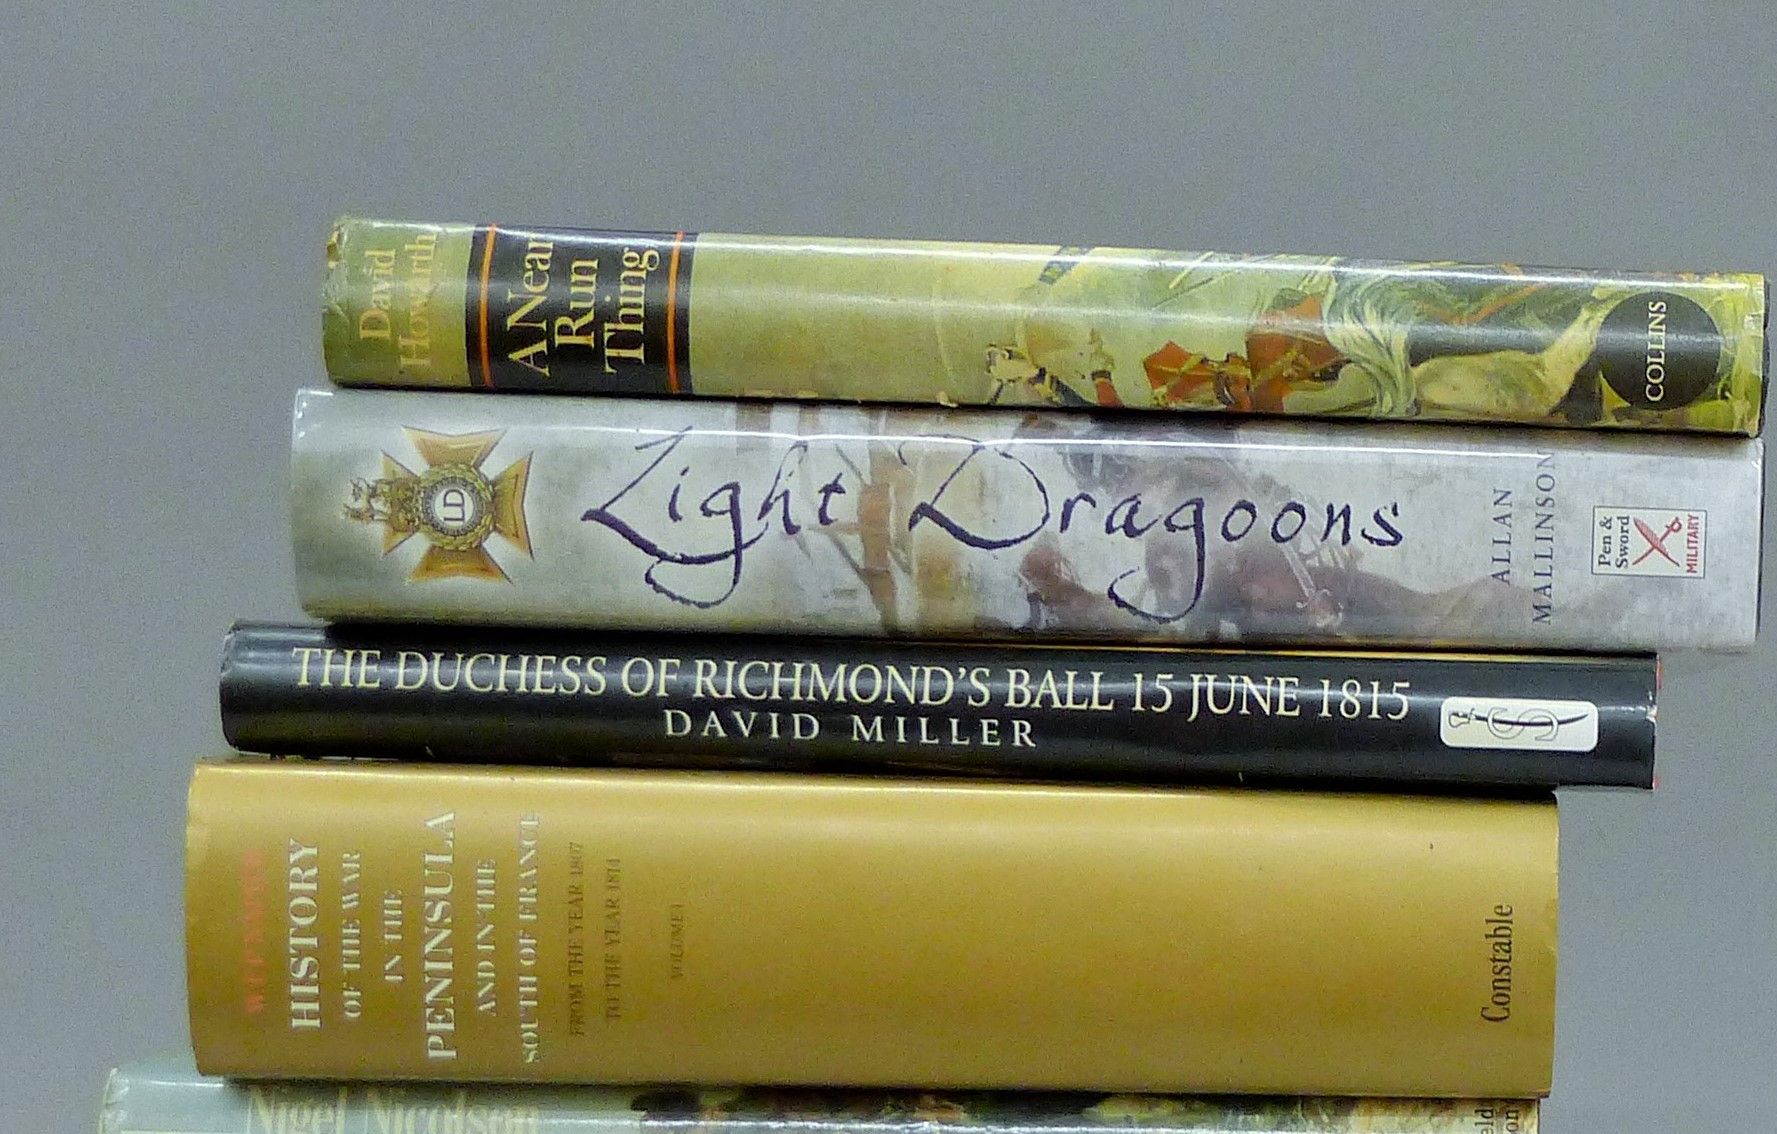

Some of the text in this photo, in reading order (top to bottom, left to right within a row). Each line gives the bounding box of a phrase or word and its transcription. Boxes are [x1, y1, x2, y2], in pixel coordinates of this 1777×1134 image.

[359, 248, 396, 341] David
[507, 236, 554, 378] A Near
[555, 257, 599, 349] Run
[603, 246, 661, 374] Thing
[1645, 299, 1669, 404] COLLINS
[582, 427, 1404, 623] Light Dragoons
[1491, 487, 1513, 585] ALLAN
[1530, 451, 1557, 626] MALLINSON
[1598, 515, 1613, 567] Pen &
[1615, 515, 1631, 570] Sword
[1685, 513, 1700, 574] MILITARY
[293, 646, 1412, 722] THE DUCHESS OF RICHMOND'S BALL 15 JUNE 1815
[665, 708, 1038, 748] DAVID MILLER
[288, 837, 323, 1031] HISTORY
[424, 810, 458, 1061] PENINSULA
[1480, 903, 1515, 1023] Constable
